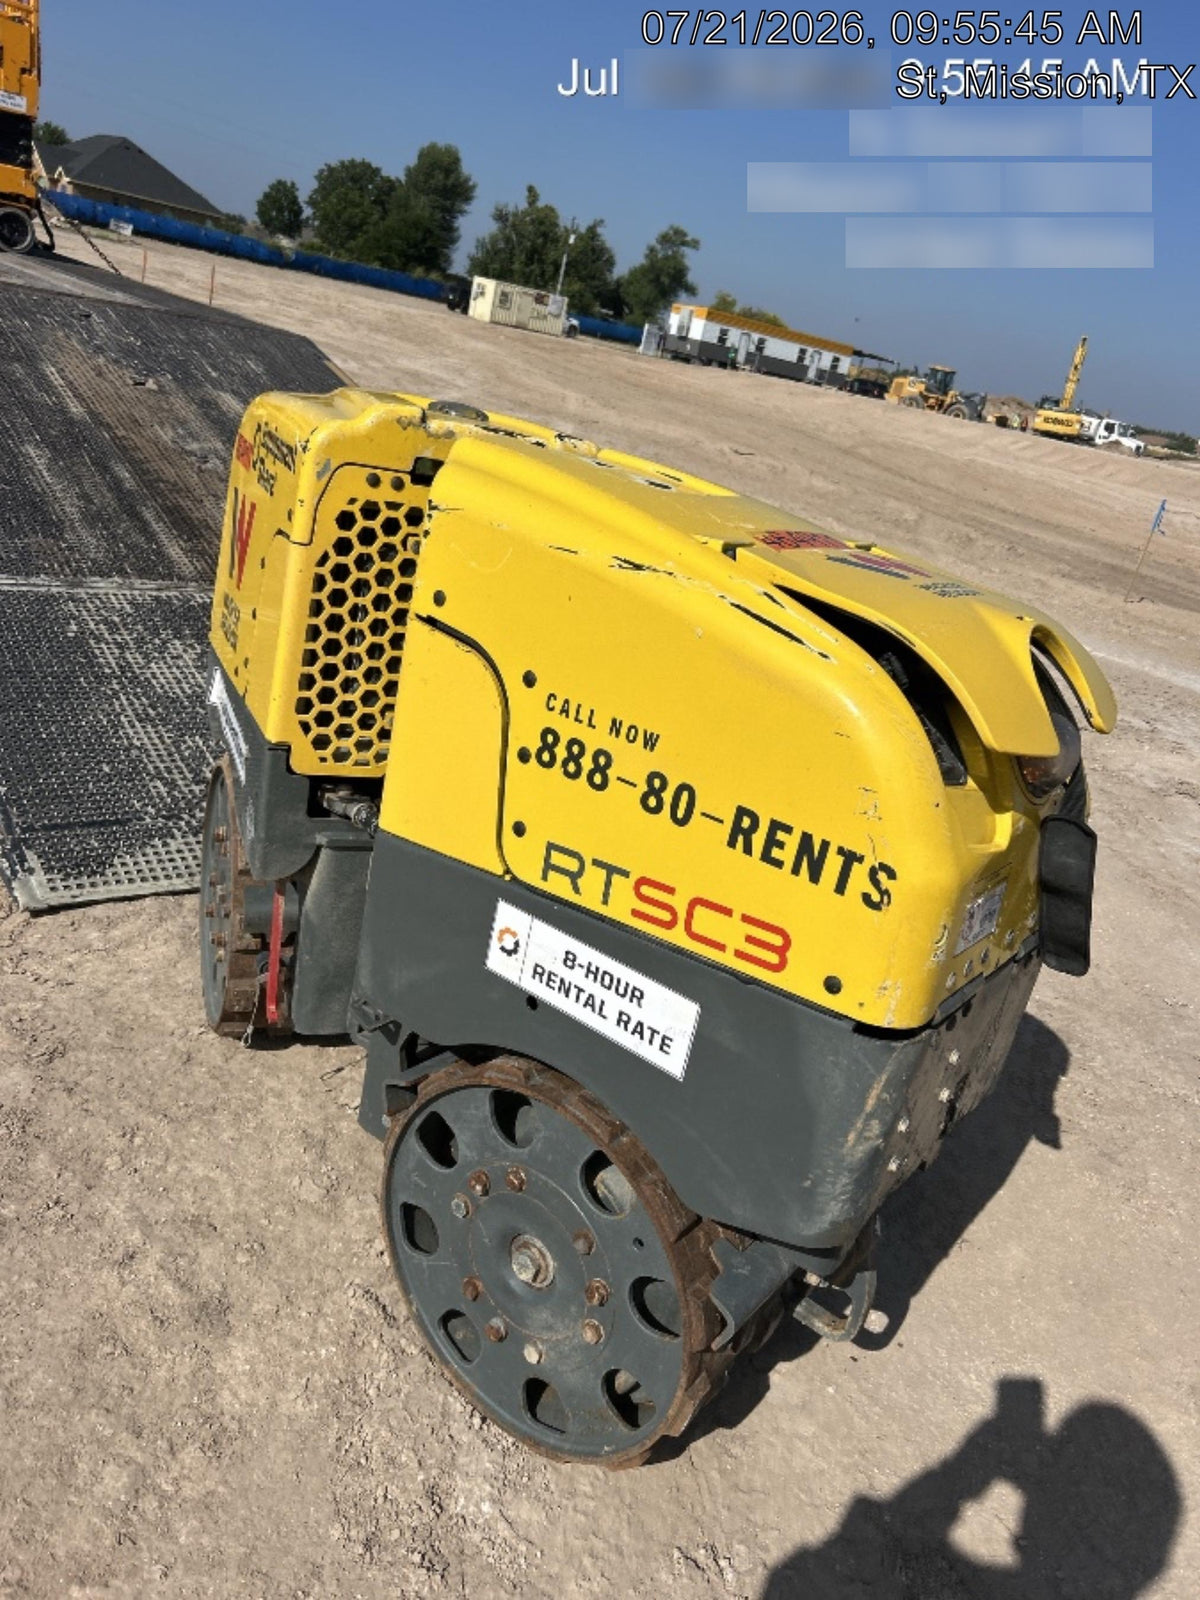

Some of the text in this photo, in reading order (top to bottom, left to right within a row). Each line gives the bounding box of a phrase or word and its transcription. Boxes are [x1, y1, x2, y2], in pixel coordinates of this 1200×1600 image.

[546, 692, 660, 752] CALL NOW
[534, 726, 898, 912] 888-80-RENTS
[531, 963, 674, 1055] RENTAL RATE
[563, 950, 645, 1009] 8-HOUR
